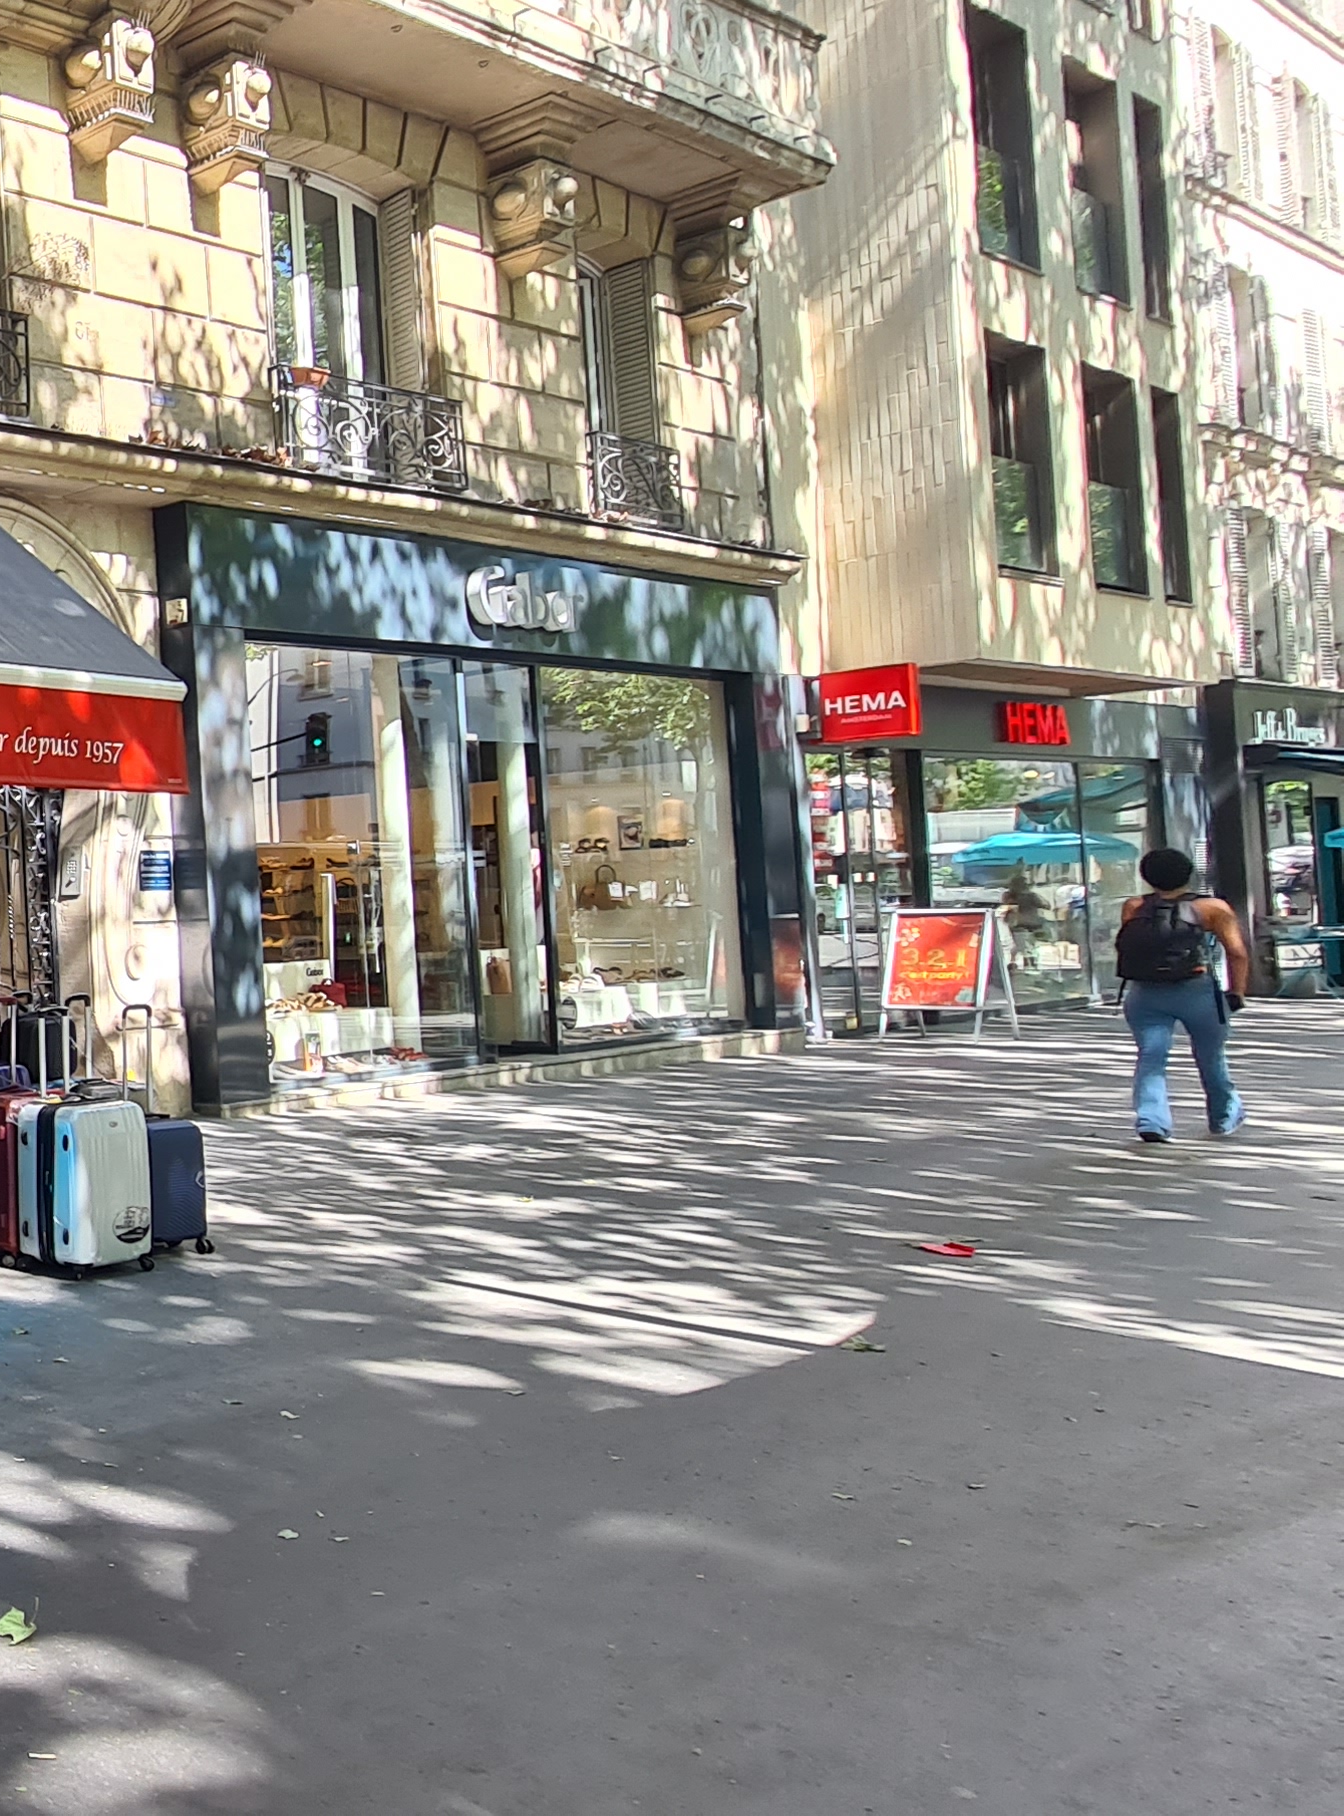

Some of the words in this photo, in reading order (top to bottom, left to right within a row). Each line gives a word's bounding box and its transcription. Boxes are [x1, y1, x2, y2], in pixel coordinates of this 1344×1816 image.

[466, 565, 589, 633] Gabor
[824, 690, 906, 716] HEMA
[1004, 701, 1071, 745] HEMA
[14, 725, 79, 765] depuis
[84, 740, 125, 765] 1957
